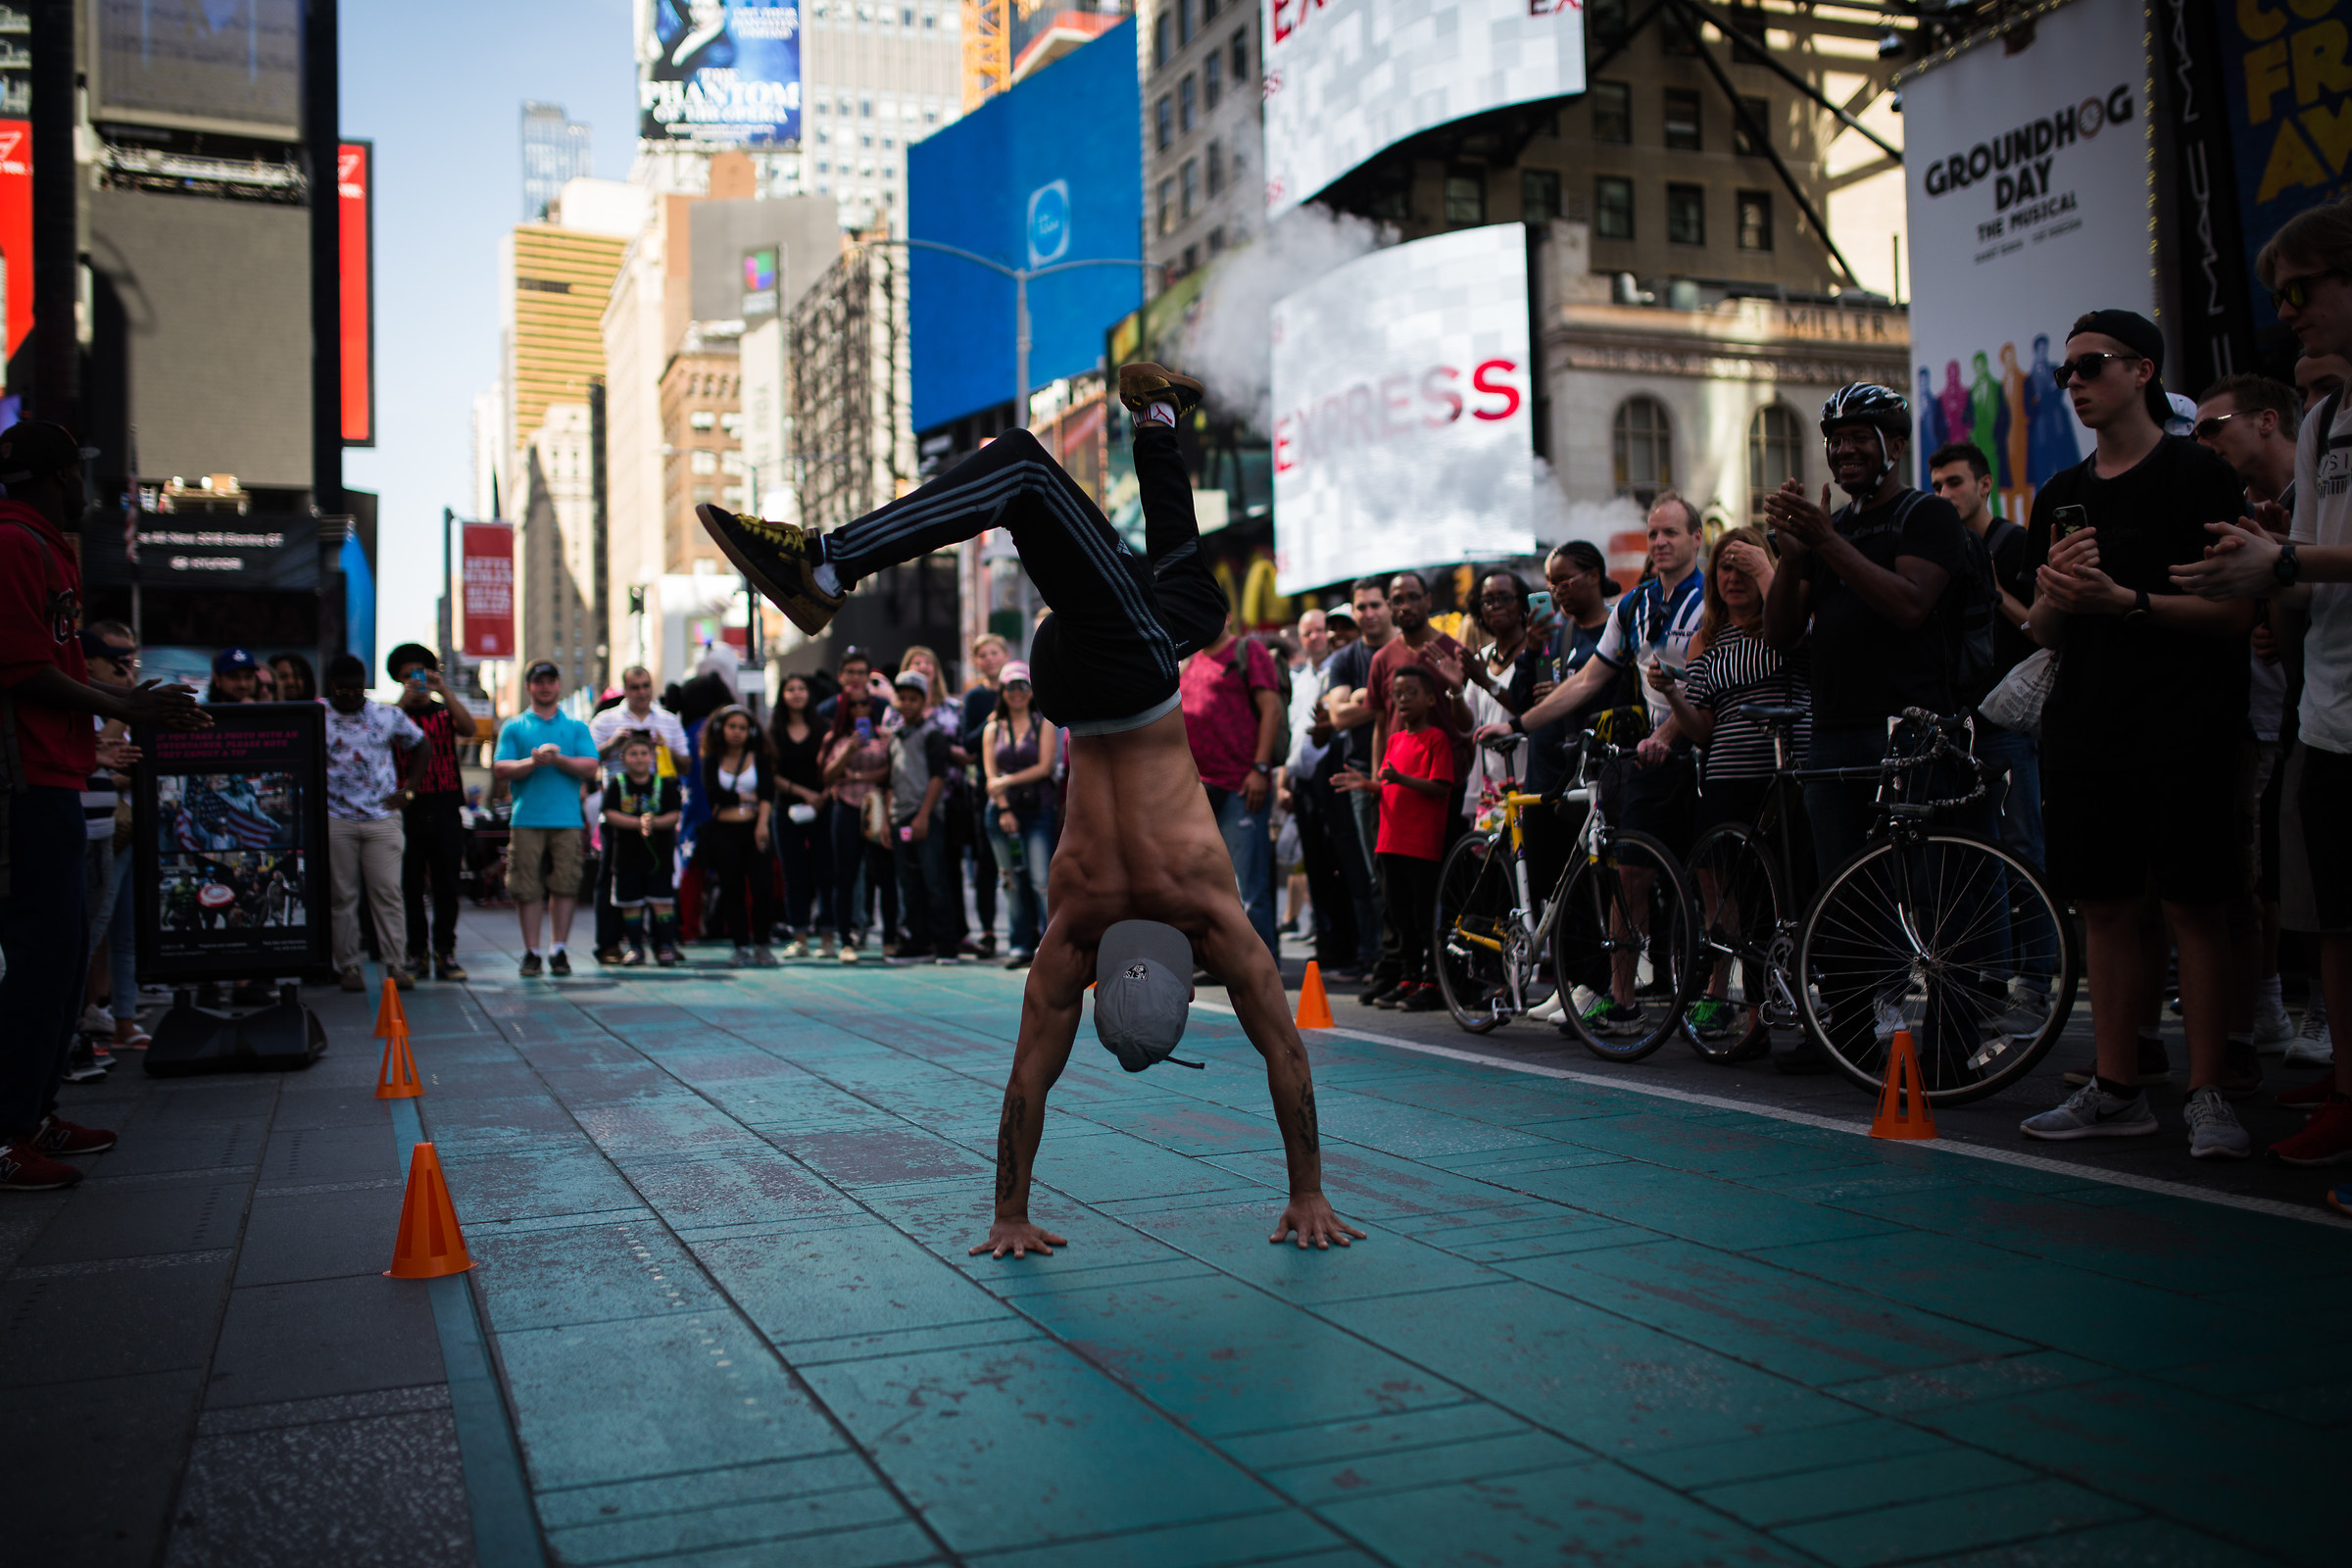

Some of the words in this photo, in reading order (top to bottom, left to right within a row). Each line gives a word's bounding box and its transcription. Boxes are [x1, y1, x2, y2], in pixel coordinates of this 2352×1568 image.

[640, 80, 801, 110] PHANTOM
[721, 104, 788, 124] OPERA
[1926, 83, 2134, 196] GROUNDHOG
[1995, 155, 2054, 212] DAY
[1978, 217, 2004, 241] THE
[2010, 190, 2078, 231] MUSICAL
[1784, 307, 1889, 340] MILLER
[1275, 358, 1520, 473] EXPRESS
[224, 731, 255, 740] PHOTO
[258, 730, 281, 739] WITH
[263, 739, 288, 748] NOTE
[183, 750, 220, 759] EXPECT
